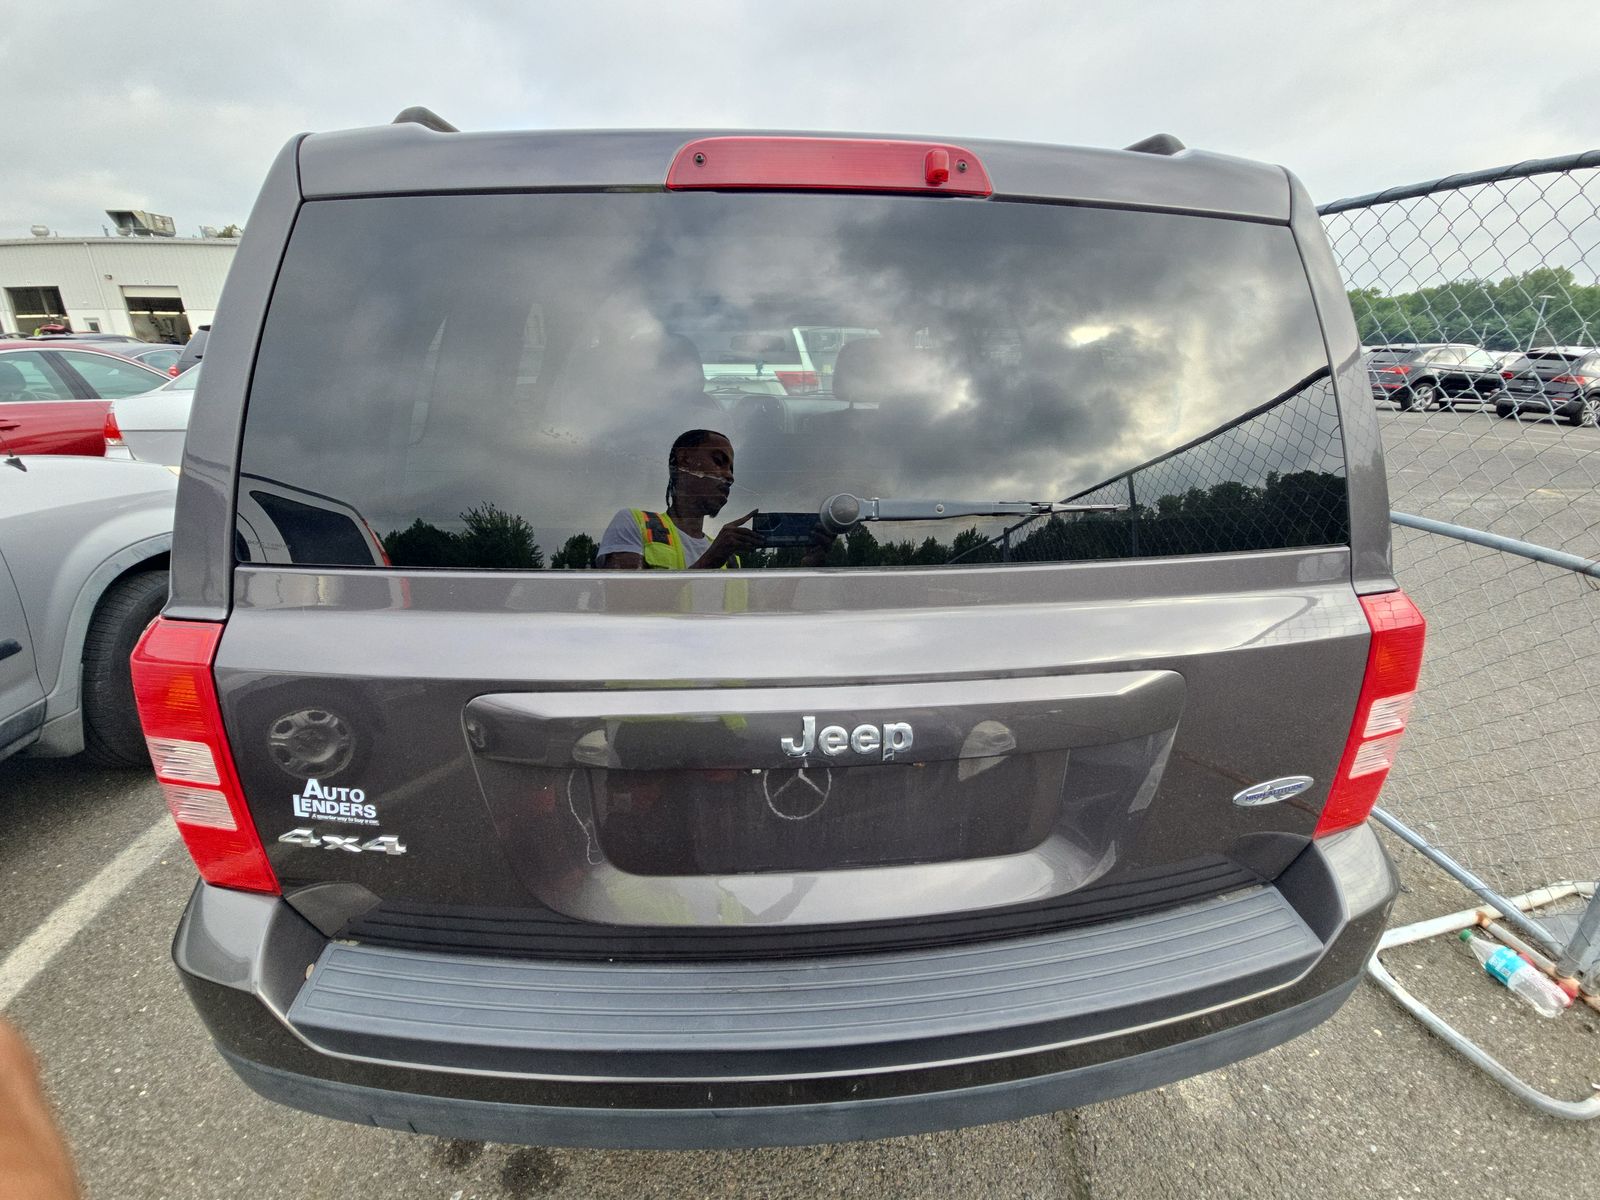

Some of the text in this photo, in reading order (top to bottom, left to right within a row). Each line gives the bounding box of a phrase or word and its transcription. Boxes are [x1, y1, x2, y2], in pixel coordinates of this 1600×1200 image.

[780, 715, 914, 761] Jeep
[303, 778, 365, 802] AUTO
[292, 794, 377, 819] LENDERS
